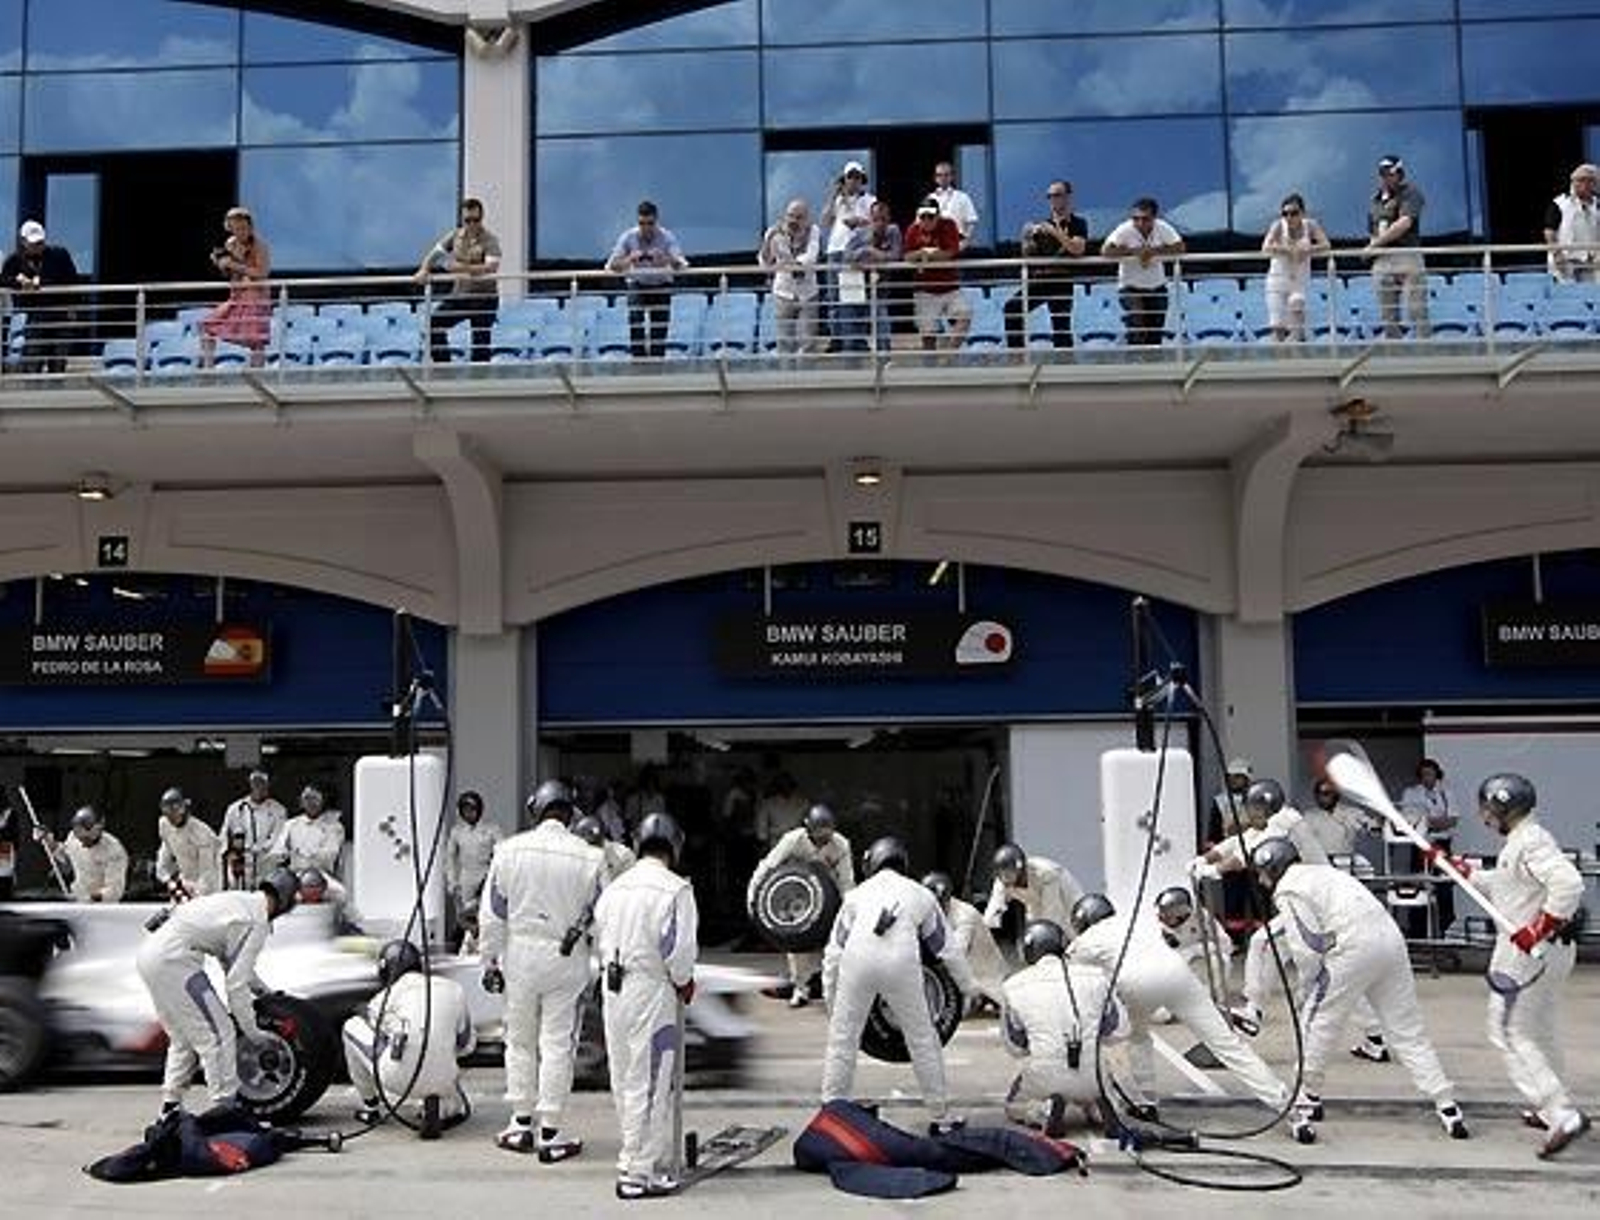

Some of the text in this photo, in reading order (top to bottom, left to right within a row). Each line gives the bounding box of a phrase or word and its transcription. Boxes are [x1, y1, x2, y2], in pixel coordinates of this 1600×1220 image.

[853, 529, 878, 547] 15
[102, 543, 126, 561] 14
[766, 625, 906, 643] BMW SAUBER
[1498, 625, 1545, 641] BMW
[32, 633, 164, 652] BMW SAUBER
[33, 660, 163, 674] PEDRO DE LA ROSA
[772, 651, 903, 666] KAMUI KOBAYASHI
